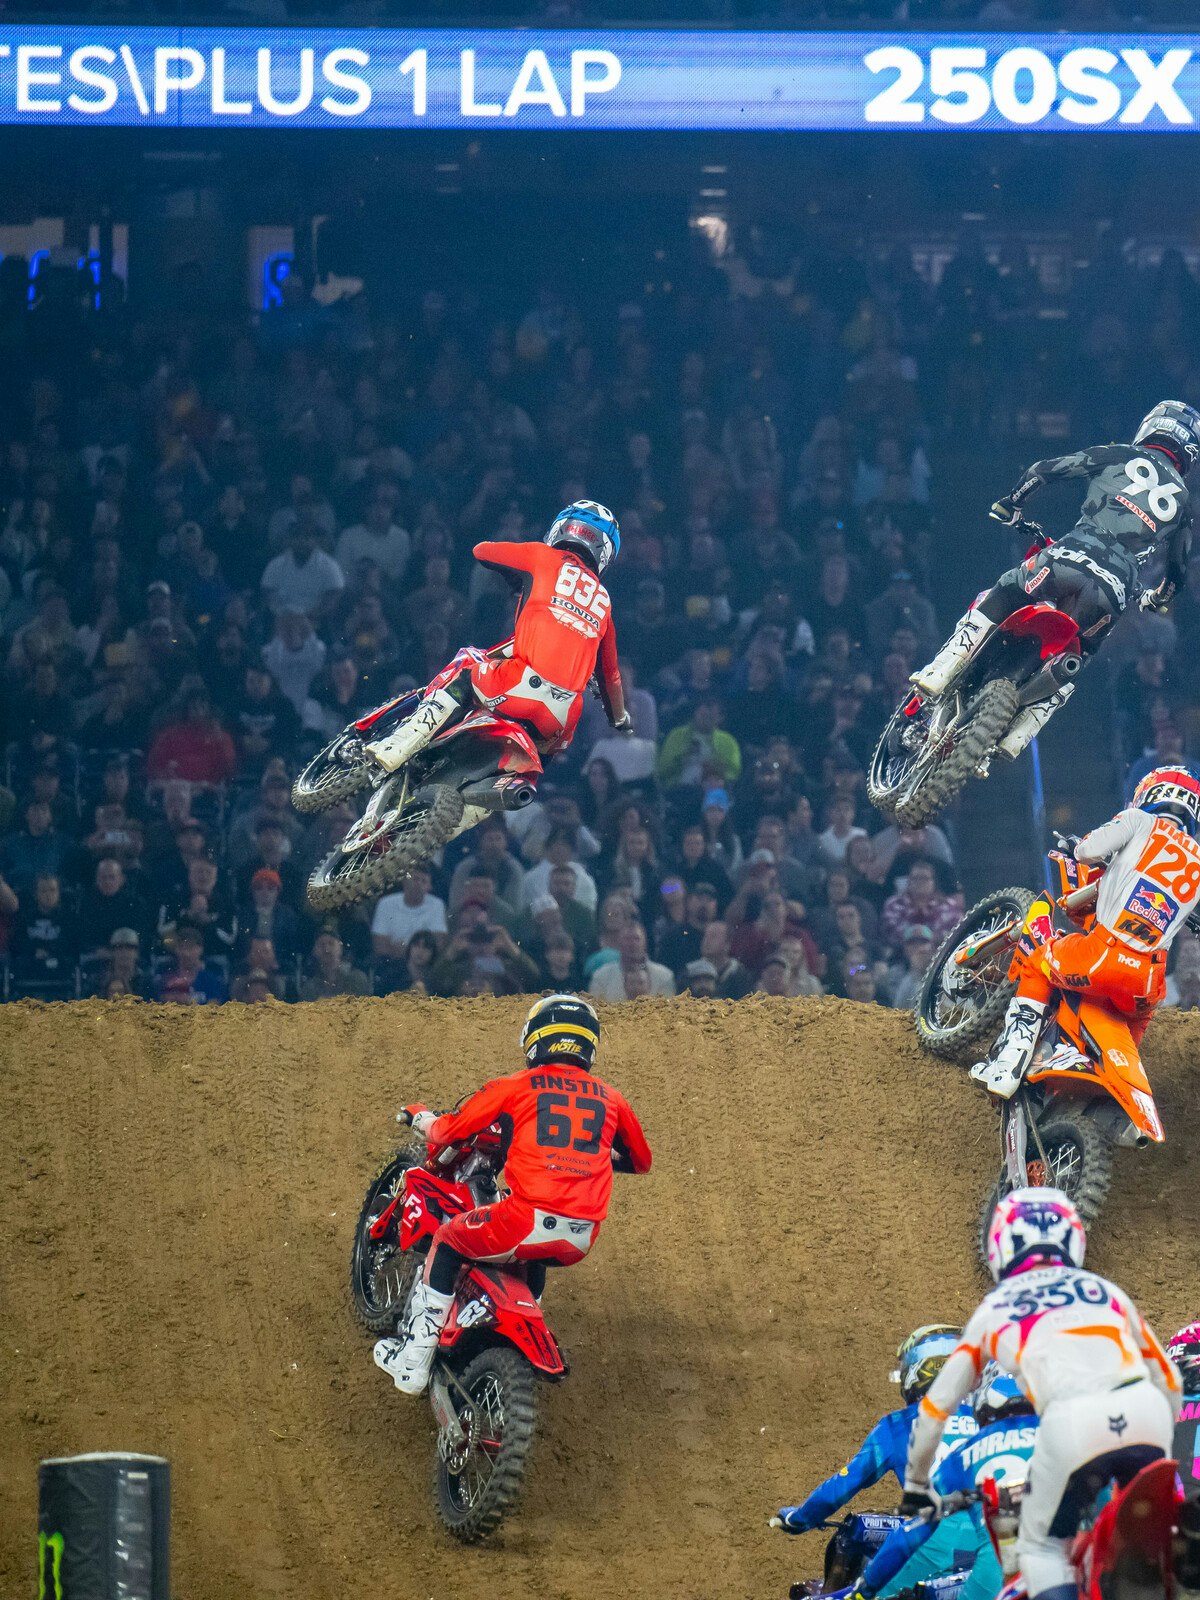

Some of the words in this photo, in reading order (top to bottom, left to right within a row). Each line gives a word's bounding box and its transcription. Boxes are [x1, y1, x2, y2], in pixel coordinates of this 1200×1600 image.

[0, 45, 371, 115] ES\PLUS
[400, 49, 427, 116] 1
[461, 49, 622, 117] LAP
[862, 46, 1194, 125] 250SX
[1121, 457, 1182, 522] 96
[1115, 495, 1157, 532] HONDA
[555, 562, 611, 620] 832
[1028, 567, 1051, 590] HONDA
[551, 596, 600, 630] HONDA
[1129, 899, 1151, 919] Red
[1118, 917, 1158, 945] KTM
[1117, 953, 1142, 970] THOR
[1064, 973, 1092, 988] KTM
[547, 1042, 583, 1054] ANSTIE
[530, 1074, 609, 1101] ANSTIE
[536, 1091, 607, 1155] 63
[565, 1165, 593, 1178] POWER
[960, 1426, 1041, 1471] THRAS
